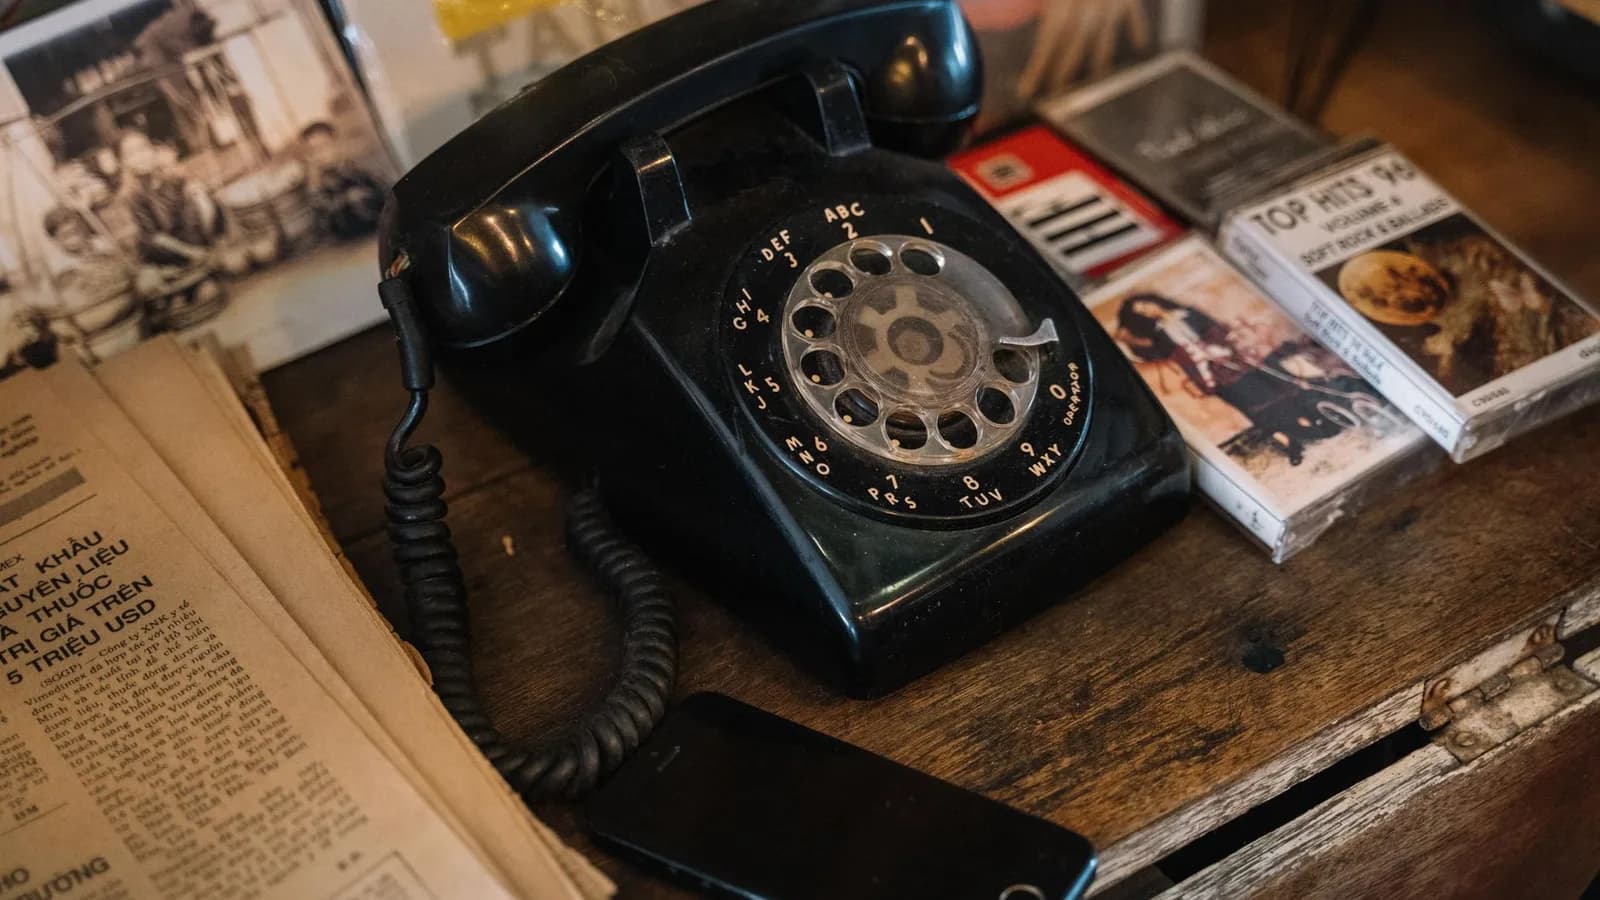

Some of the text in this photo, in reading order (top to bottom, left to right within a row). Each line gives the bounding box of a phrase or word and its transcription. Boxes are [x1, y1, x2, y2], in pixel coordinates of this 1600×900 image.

[824, 202, 864, 224] ABC
[1252, 201, 1310, 236] TOP
[1310, 176, 1374, 212] HITS
[1321, 200, 1387, 233] VOLUME
[842, 222, 861, 240] 2
[920, 218, 933, 234] 1
[761, 228, 792, 262] DEF
[784, 252, 797, 267] 3
[1301, 241, 1333, 266] SOFT
[1336, 228, 1376, 250] ROCK
[733, 288, 751, 329] GHI
[757, 309, 769, 322] 4
[765, 377, 779, 392] 5
[1061, 363, 1081, 425] OPERATOR
[783, 436, 830, 478] MNO
[815, 436, 828, 451] 6
[1021, 443, 1034, 456] 9
[1026, 443, 1064, 481] WXY
[868, 485, 916, 512] PRS
[886, 475, 902, 489] 7
[959, 486, 1002, 508] TUV
[963, 476, 979, 490] 8
[75, 539, 129, 576] LIỆU
[25, 574, 112, 624] THUỐC
[39, 613, 85, 643] GIÁ
[85, 575, 153, 617] TRÊN
[6, 599, 156, 685] 5 TRIỆU USD
[40, 663, 82, 688] (SGGP)
[98, 639, 128, 657] Công
[140, 614, 169, 634] XNK
